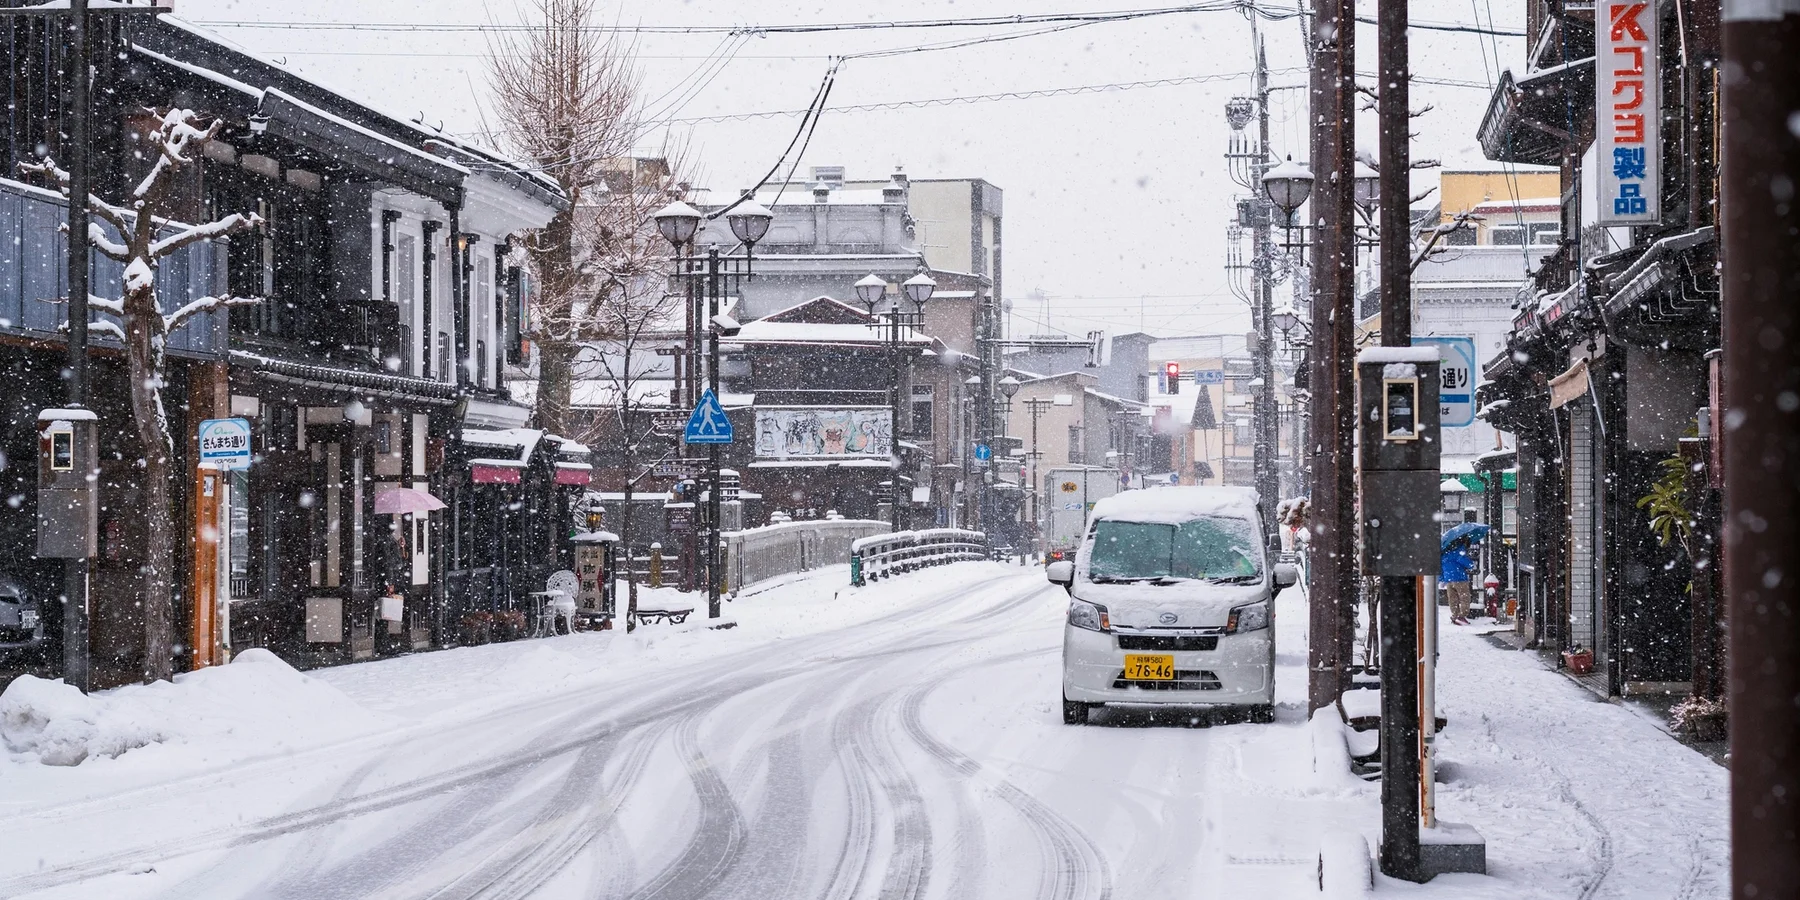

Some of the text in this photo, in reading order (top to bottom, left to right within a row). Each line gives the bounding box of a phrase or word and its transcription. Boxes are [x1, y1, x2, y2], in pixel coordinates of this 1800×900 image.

[203, 436, 246, 449] さんまち通り
[1136, 665, 1171, 677] 78-46
